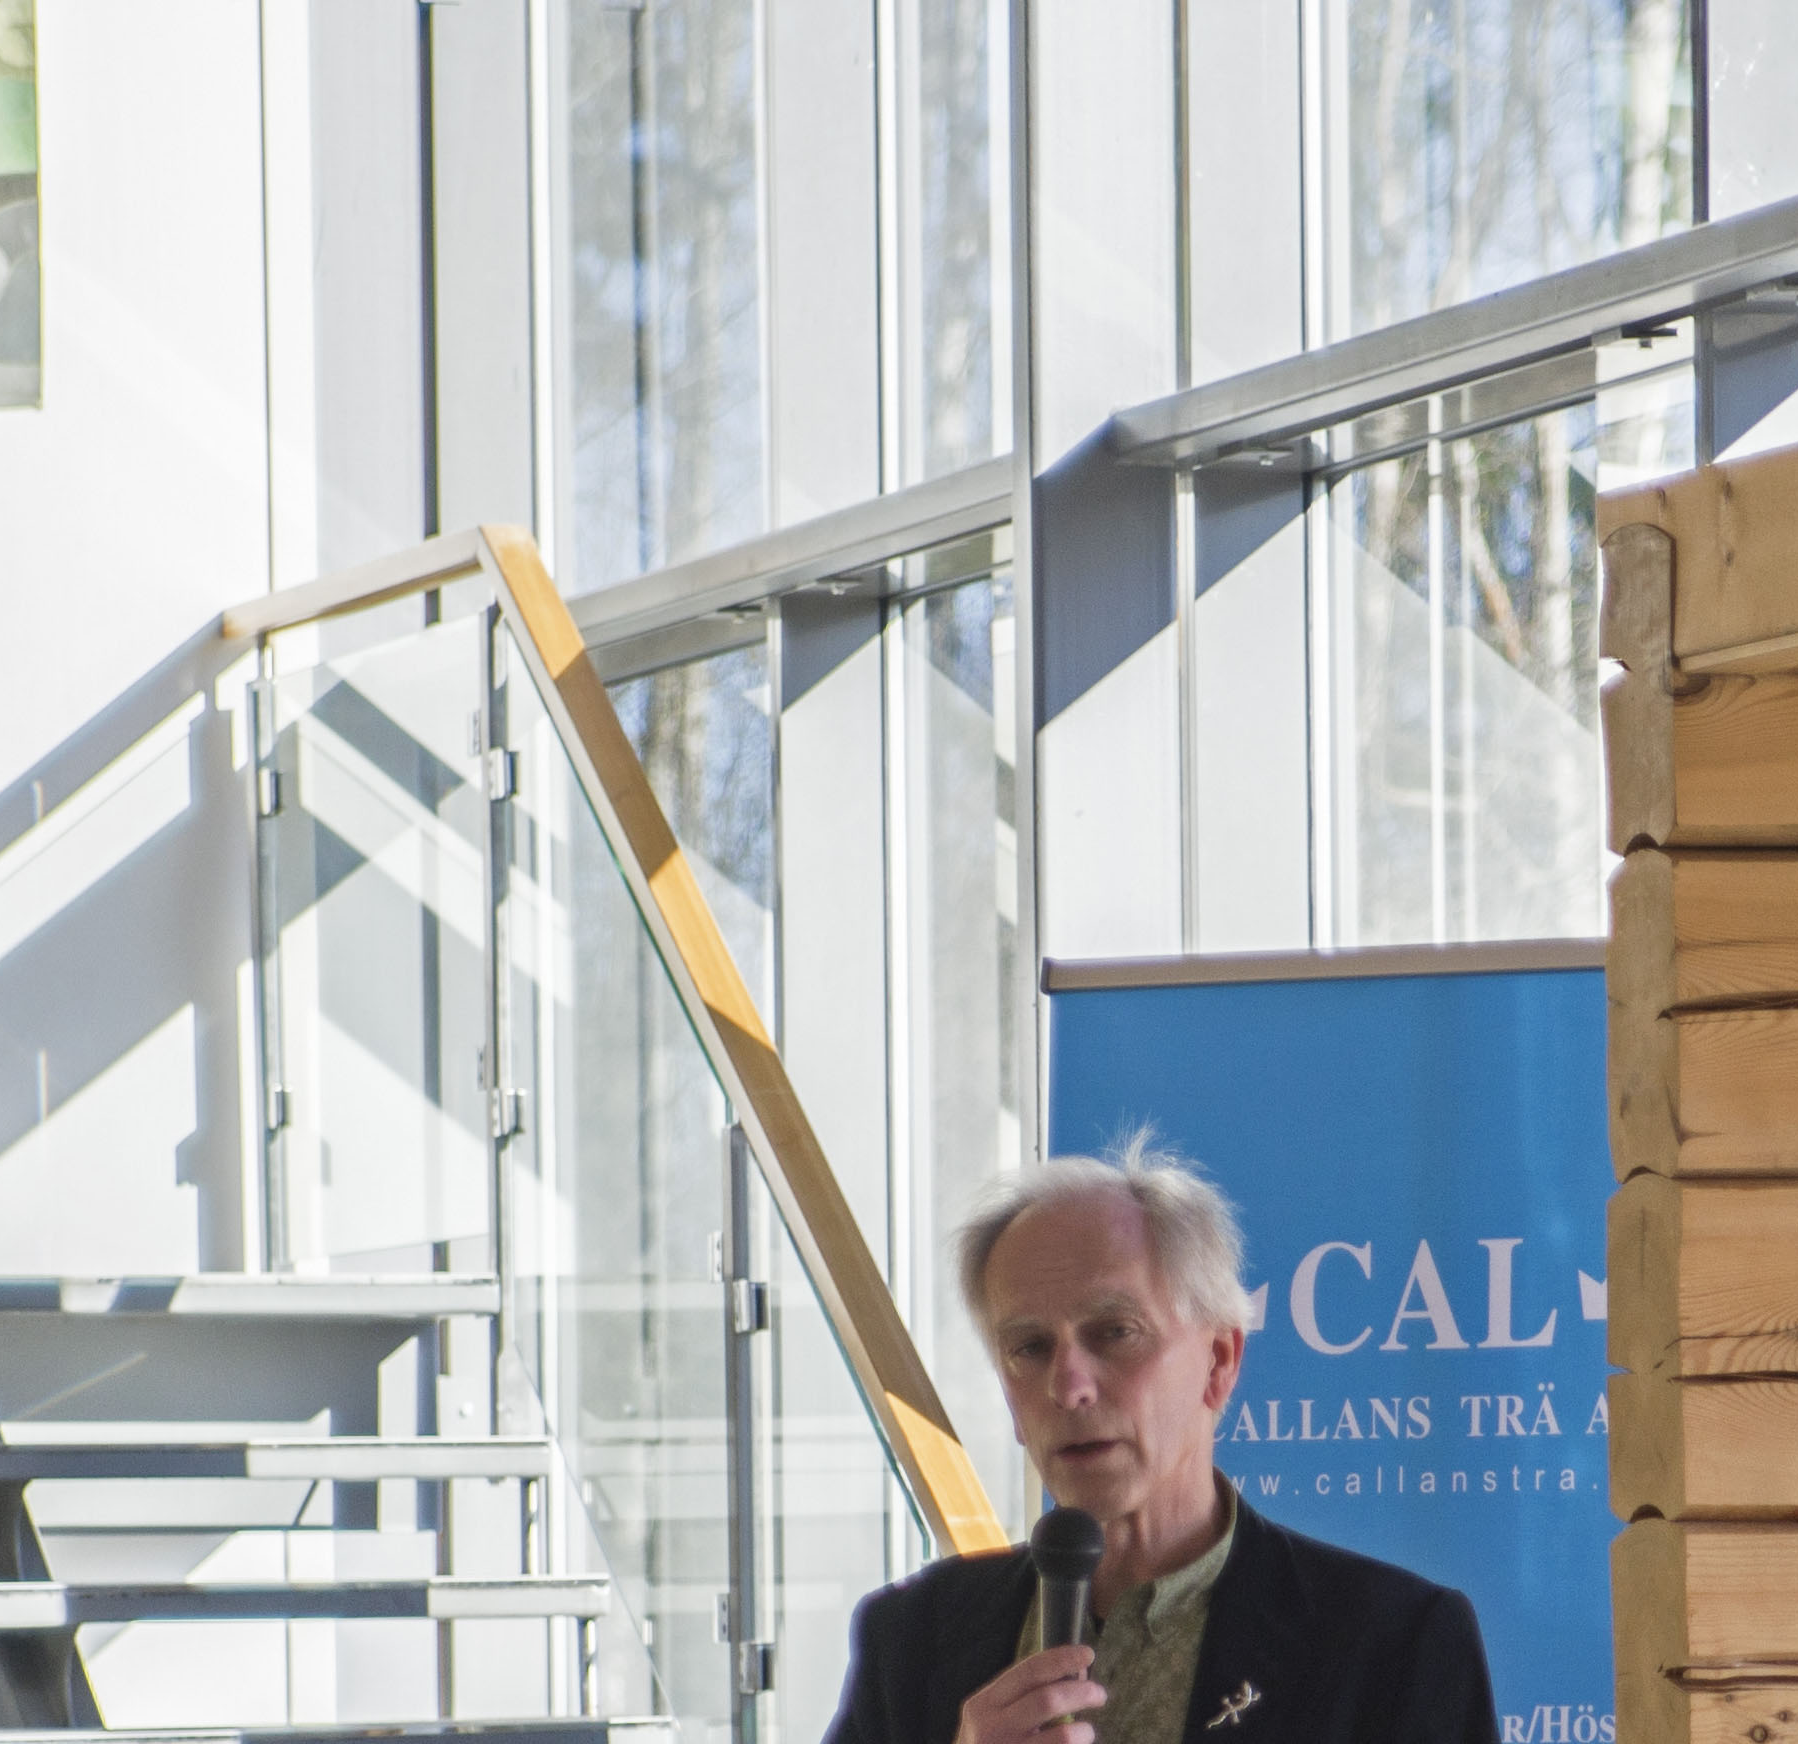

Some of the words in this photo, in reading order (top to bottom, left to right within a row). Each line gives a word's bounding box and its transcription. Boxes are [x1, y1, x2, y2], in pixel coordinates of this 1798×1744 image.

[1290, 1238, 1558, 1356] CAL
[1213, 1396, 1432, 1442] ALLANS
[1460, 1382, 1563, 1438] TRÄ
